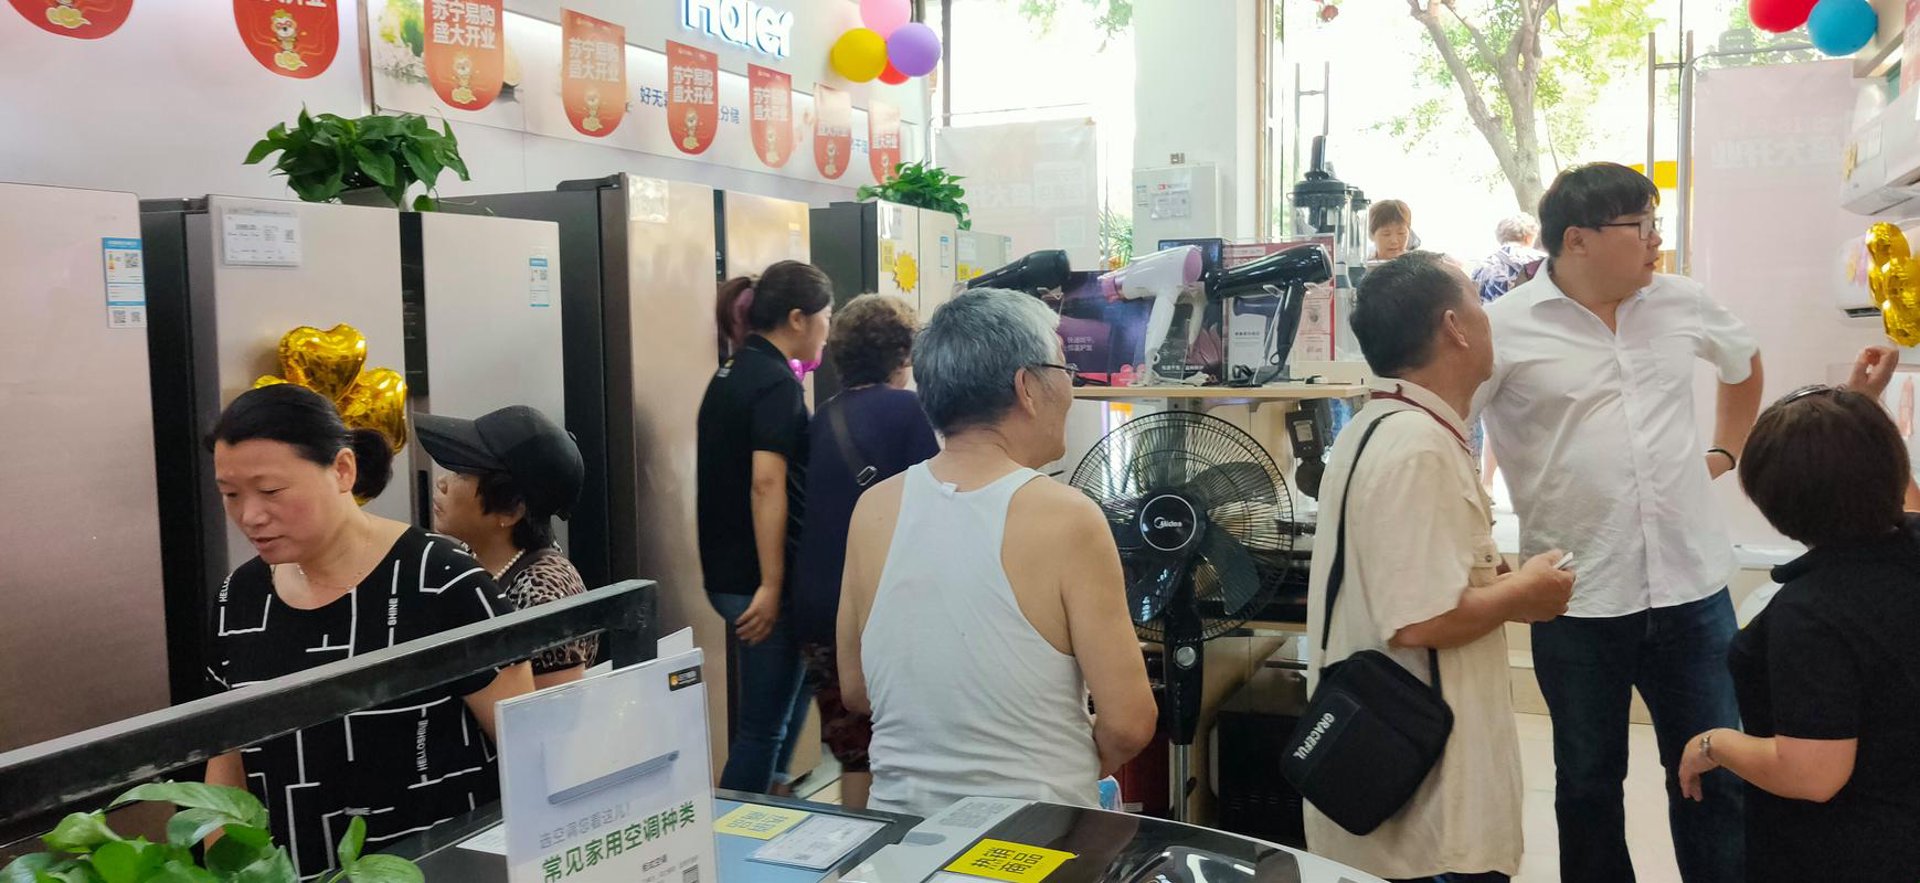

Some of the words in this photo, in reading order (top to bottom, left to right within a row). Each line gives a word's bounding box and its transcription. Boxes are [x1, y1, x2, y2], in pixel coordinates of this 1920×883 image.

[432, 0, 495, 27] 苏宁易购
[433, 21, 496, 49] 盛大开业
[569, 37, 619, 62] 苏宁易购
[569, 59, 619, 82] 盛大开业
[672, 65, 714, 87] 苏宁易购
[673, 84, 714, 105] 盛大开业
[387, 597, 399, 626] SHINE
[1292, 712, 1335, 760] GRACEFUL
[542, 801, 695, 883] 常见家用空调种类
[970, 847, 1016, 871] 热销
[998, 852, 1044, 875] 商品
